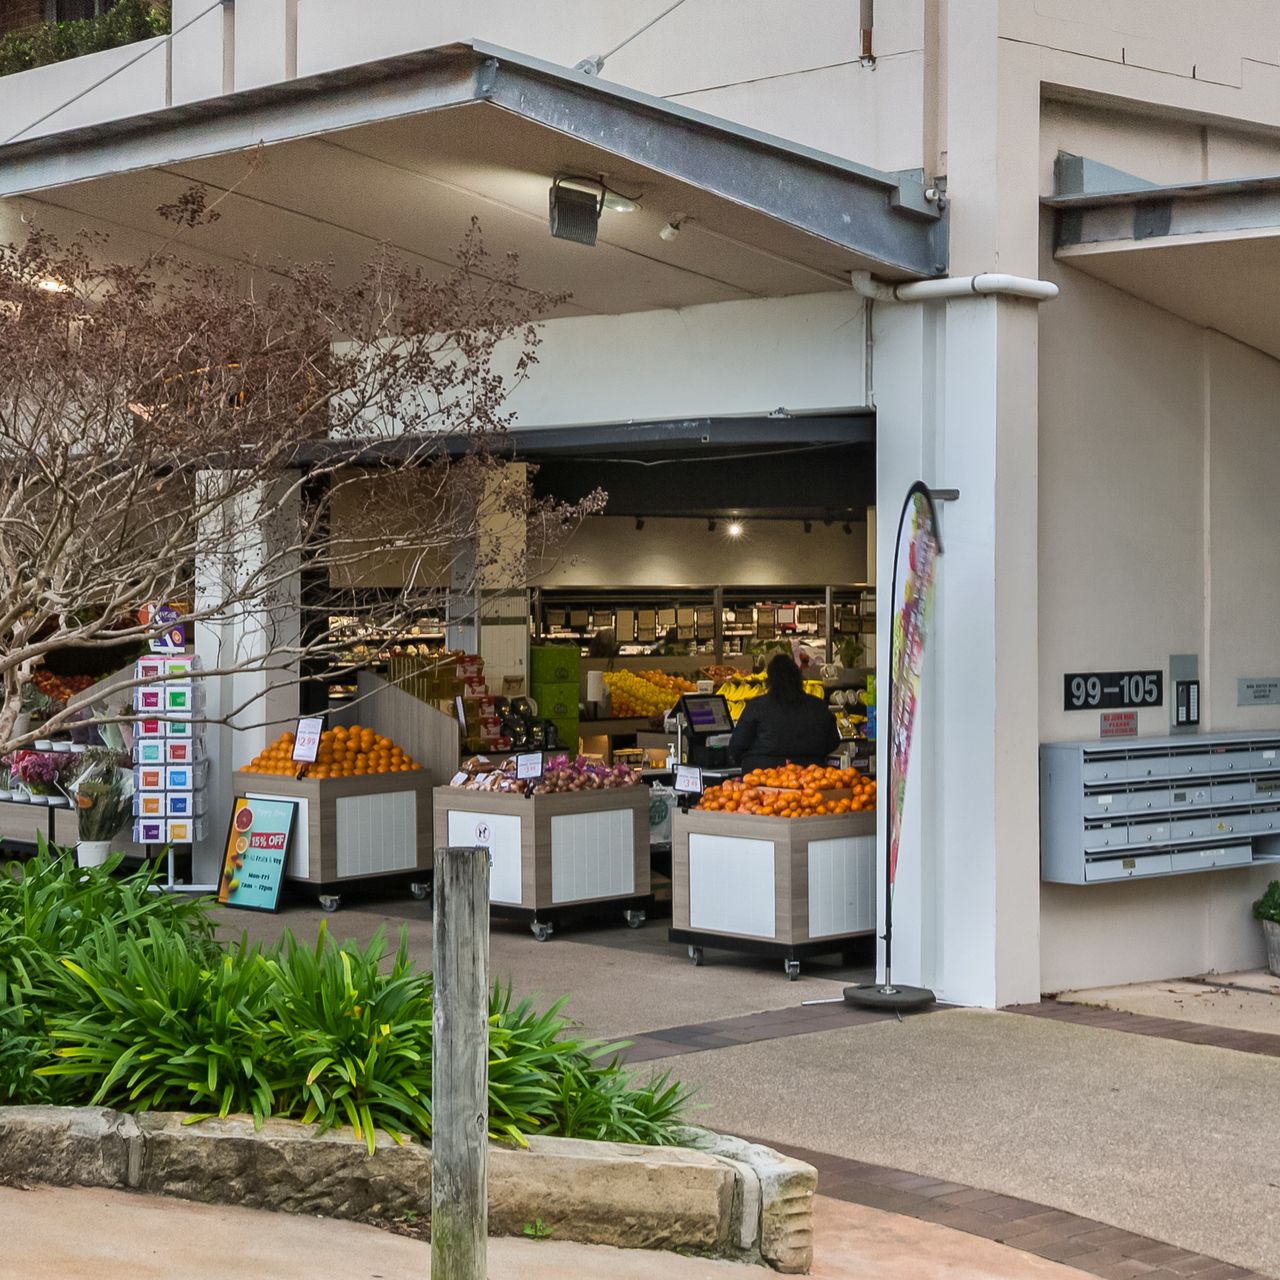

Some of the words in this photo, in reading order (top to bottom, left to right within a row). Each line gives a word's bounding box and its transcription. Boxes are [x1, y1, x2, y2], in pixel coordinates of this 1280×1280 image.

[1071, 675, 1158, 707] 99-105
[251, 835, 267, 848] 15%
[268, 834, 285, 847] OFF
